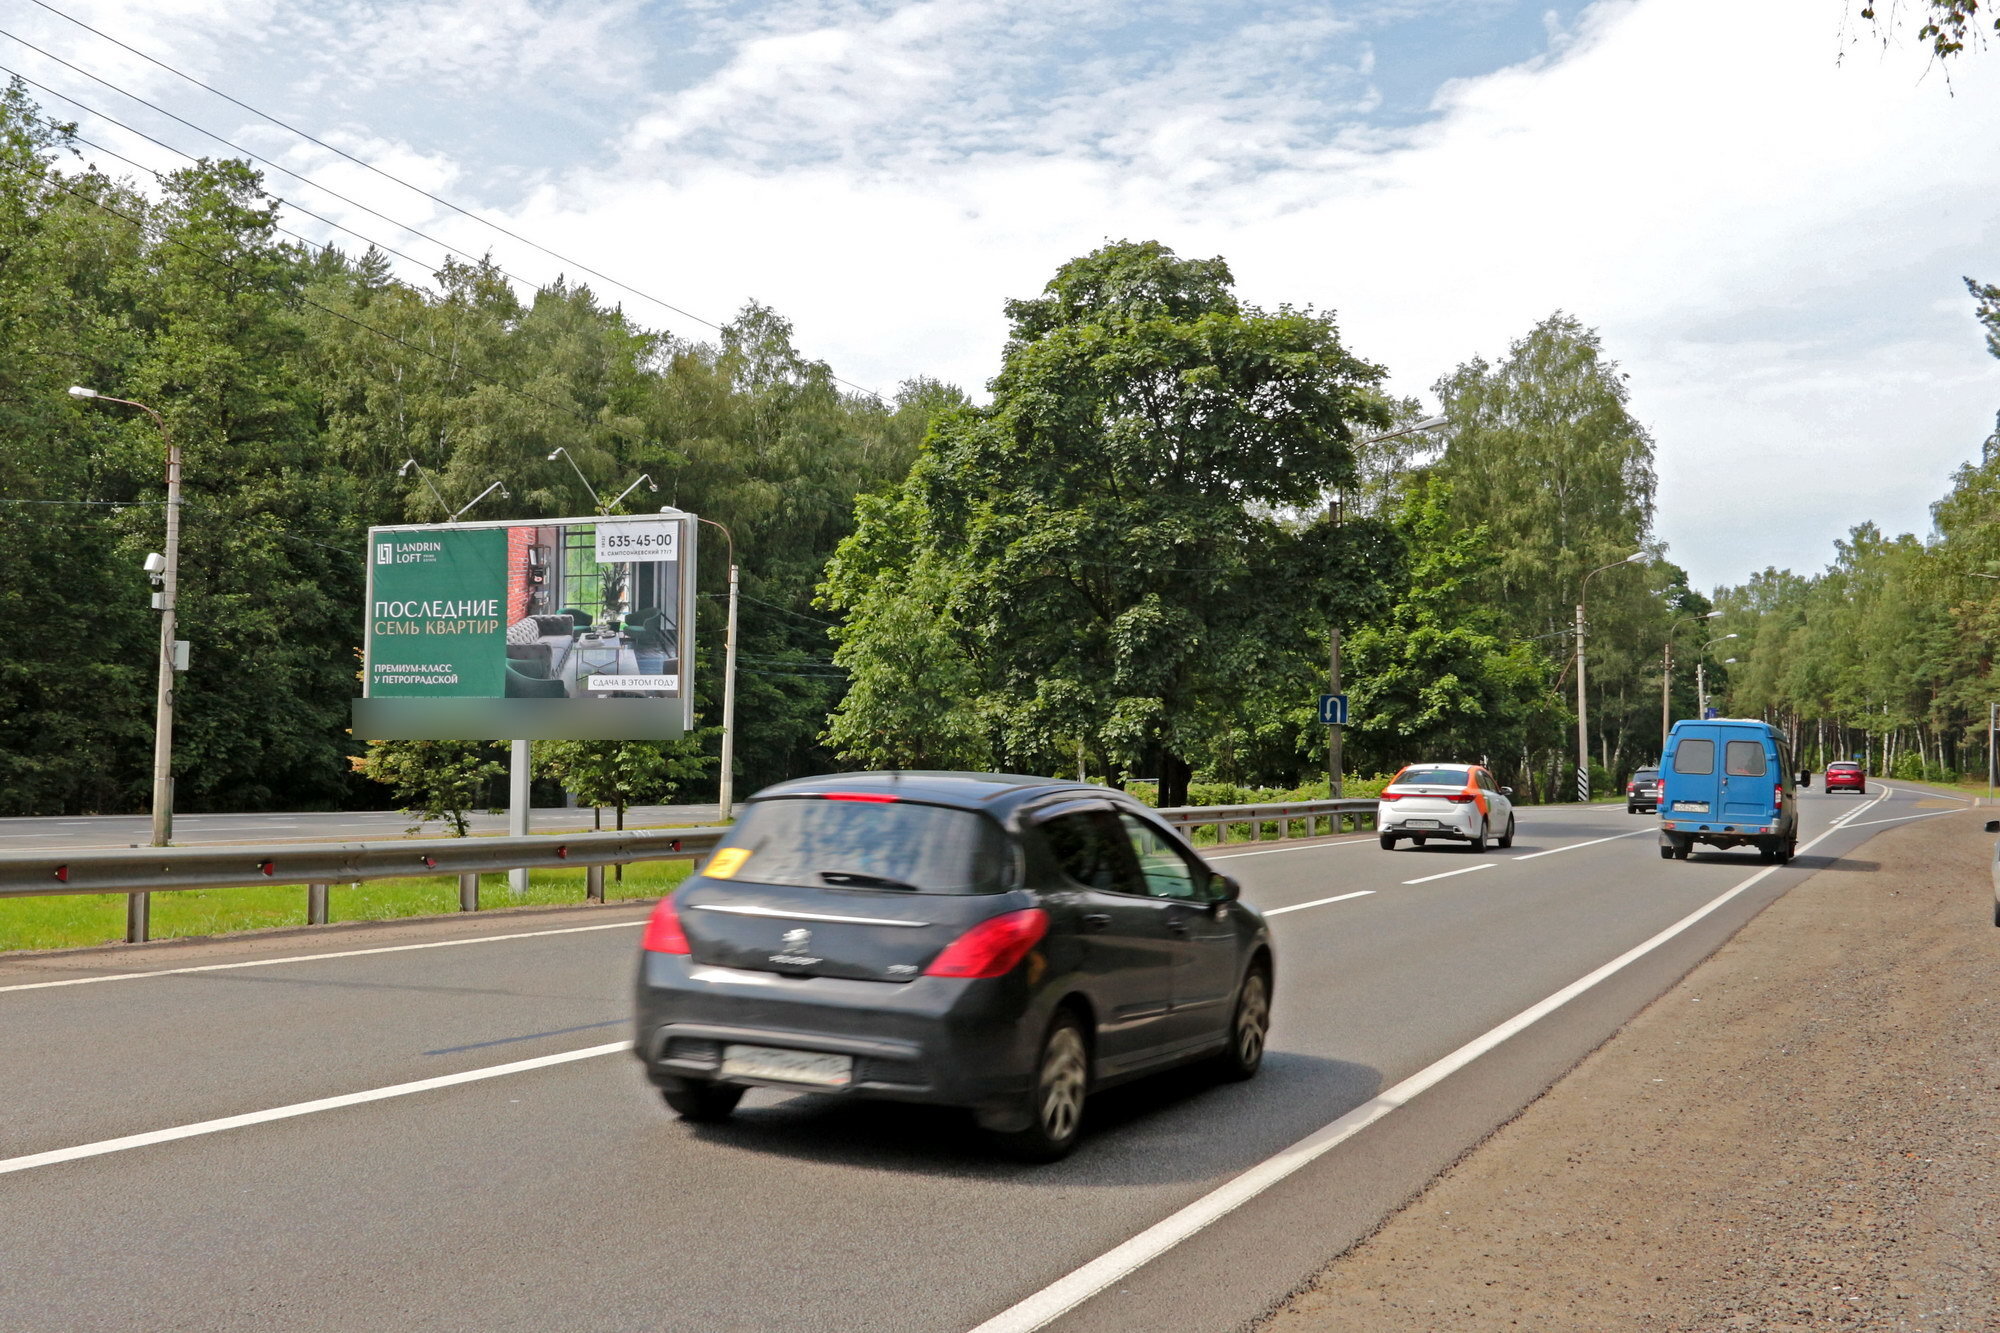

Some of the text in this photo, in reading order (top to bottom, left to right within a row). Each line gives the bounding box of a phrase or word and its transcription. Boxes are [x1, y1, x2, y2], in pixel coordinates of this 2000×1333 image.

[608, 534, 672, 547] 635-45-00
[396, 542, 441, 552] LANDRIN
[396, 553, 421, 563] LOFT
[375, 600, 499, 619] ПОСЛЕДНИЕ
[374, 620, 499, 635] СЕМЬ КВАРТИР
[374, 664, 453, 673] ПРЕМИУМ-КЛАСС
[373, 674, 458, 684] У ПЕТРОГРАДСКОЙ
[592, 679, 619, 687] СДАЧА
